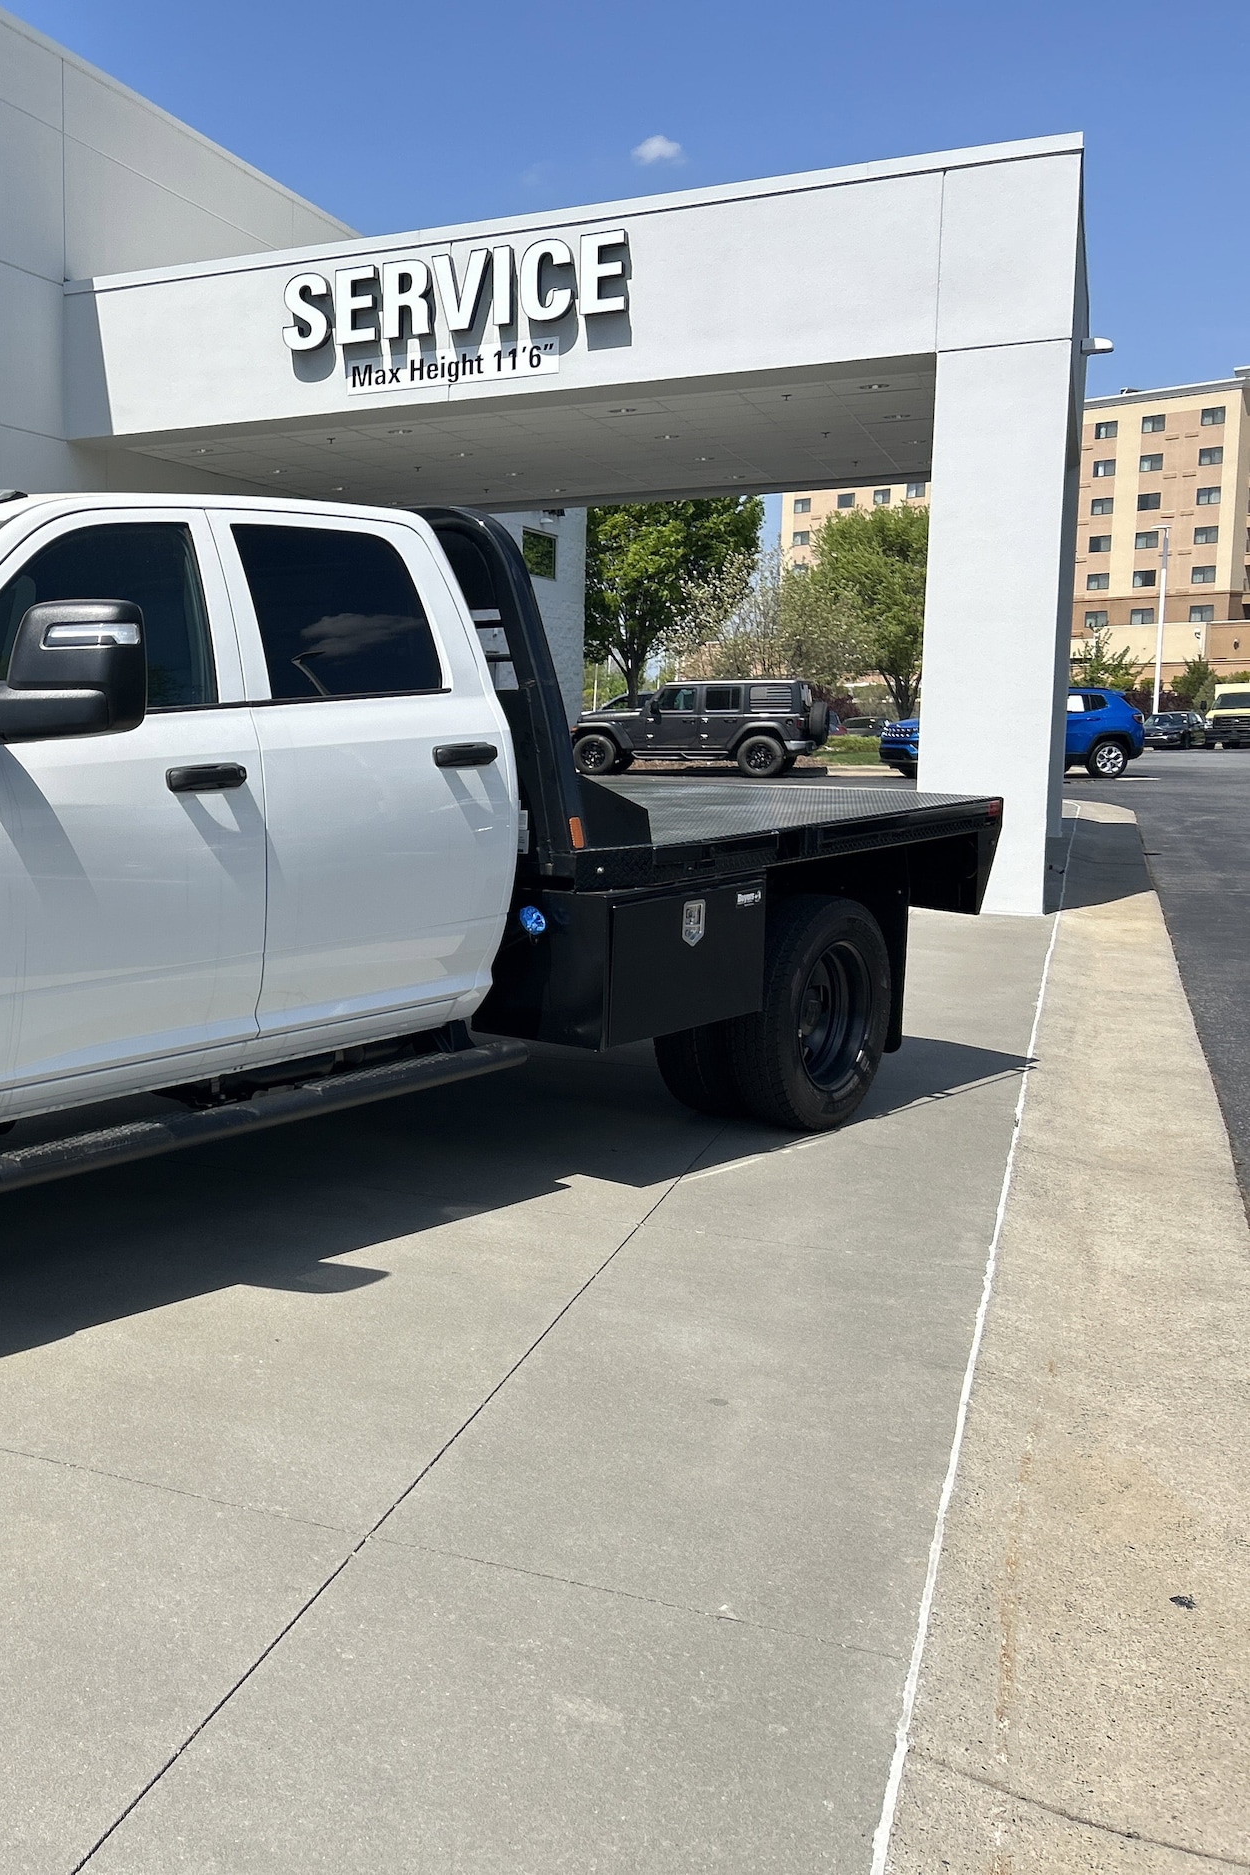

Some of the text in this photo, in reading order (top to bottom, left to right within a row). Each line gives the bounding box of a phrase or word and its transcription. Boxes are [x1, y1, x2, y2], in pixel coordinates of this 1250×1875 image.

[282, 229, 627, 352] SERVICE
[351, 363, 401, 388] Max
[409, 353, 485, 382] Height
